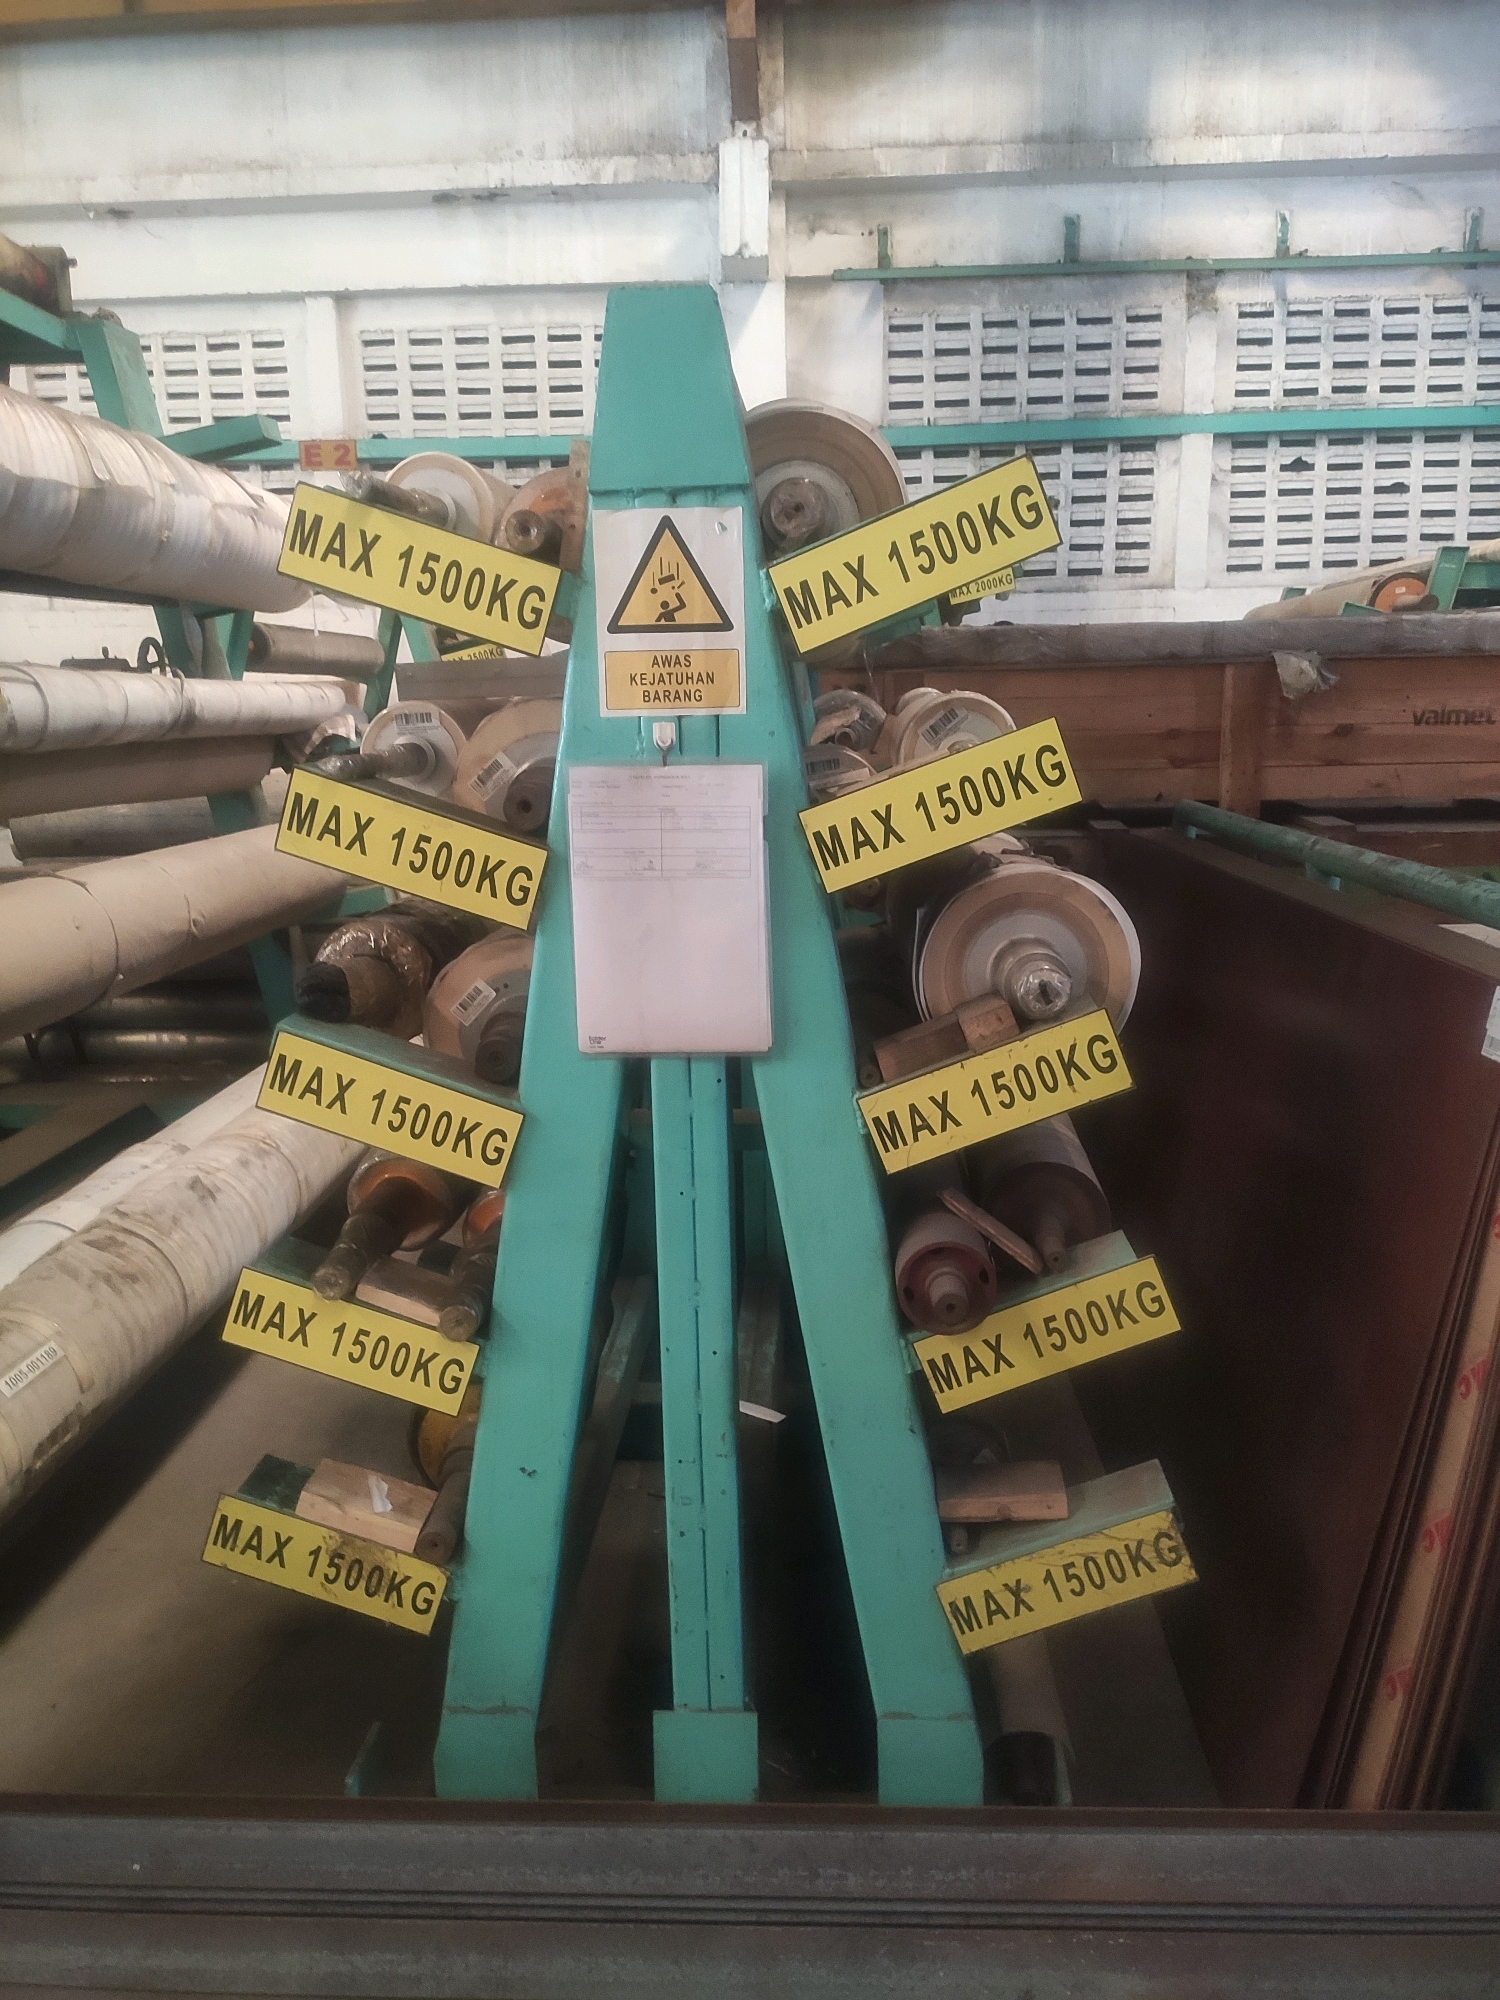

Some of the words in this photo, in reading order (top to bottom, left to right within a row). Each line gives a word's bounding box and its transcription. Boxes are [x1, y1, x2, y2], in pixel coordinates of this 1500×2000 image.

[304, 444, 323, 467] E
[334, 444, 351, 467] 2
[288, 508, 381, 577] MAX
[398, 544, 545, 630] 1500KG
[782, 554, 879, 629] MAX
[887, 484, 1043, 583] 1500KG
[949, 584, 973, 600] MAX
[975, 573, 1013, 593] 2000KG
[629, 671, 715, 687] KEJATUHAN
[642, 688, 703, 703] BARANG
[651, 654, 692, 669] AWAS
[286, 791, 374, 856] MAX
[391, 826, 532, 906] 1500KG
[811, 803, 905, 870] MAX
[914, 744, 1066, 831] 1500KG
[268, 1052, 356, 1115] MAX
[370, 1088, 507, 1166] 1500KG
[871, 1090, 962, 1153] MAX
[970, 1033, 1118, 1116] 1500KG
[232, 1288, 317, 1347] MAX
[331, 1321, 464, 1394] 1500KG
[926, 1332, 1015, 1393] MAX
[1022, 1280, 1165, 1358] 1500KG
[211, 1513, 293, 1568] MAX
[307, 1544, 436, 1616] 1500KG
[948, 1578, 1034, 1636] MAX
[1042, 1531, 1183, 1602] 1500KG
